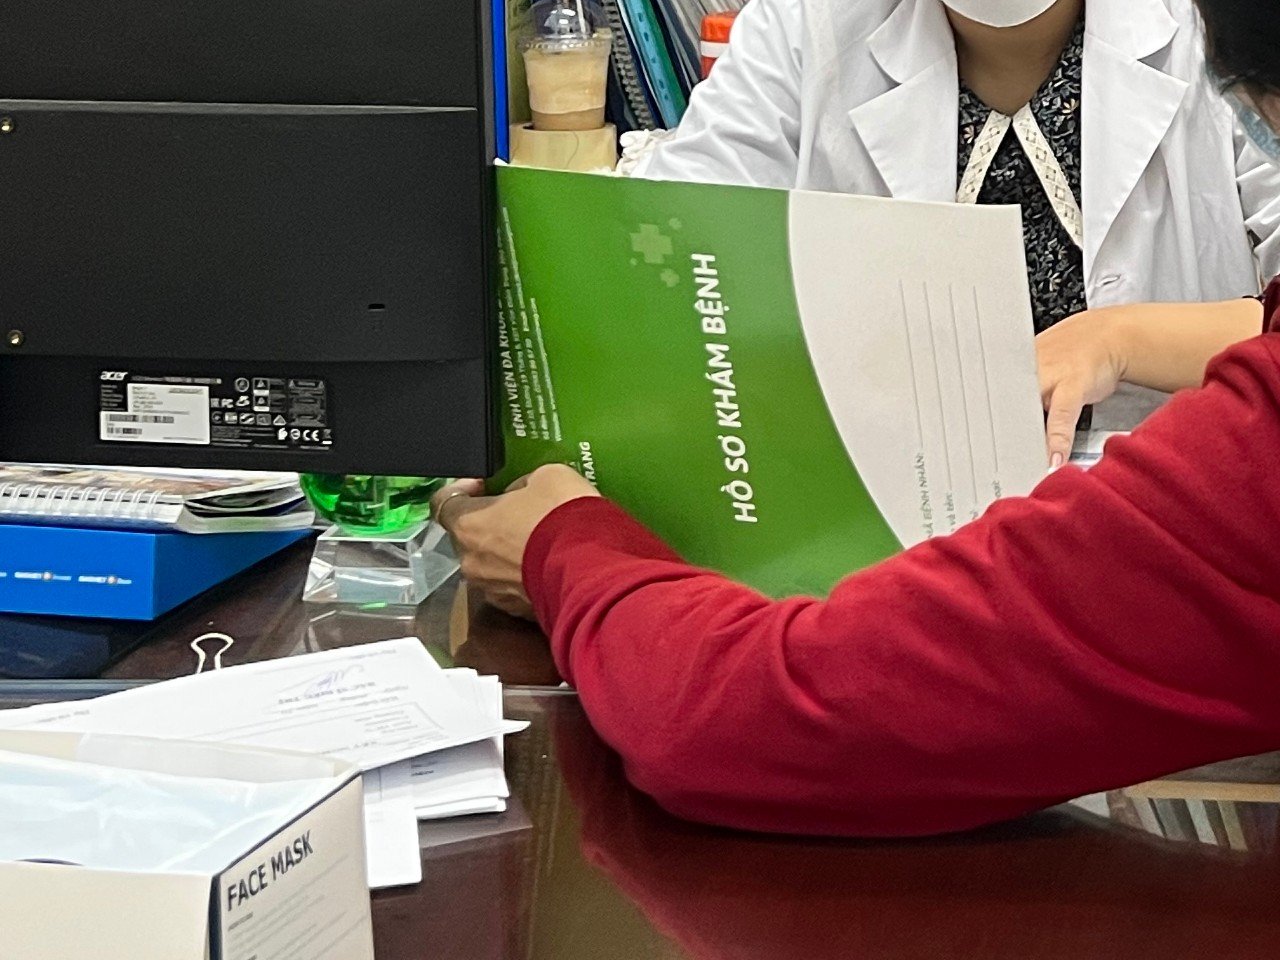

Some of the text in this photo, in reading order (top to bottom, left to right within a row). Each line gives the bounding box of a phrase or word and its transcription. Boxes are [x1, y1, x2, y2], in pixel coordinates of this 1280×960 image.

[100, 370, 128, 381] acer
[501, 350, 514, 369] ĐA
[504, 371, 519, 401] VIỆN
[690, 253, 758, 523] HỒ SƠ KHÁM BỆNH
[509, 403, 528, 437] BỆNH
[227, 829, 314, 912] FACE MASK
